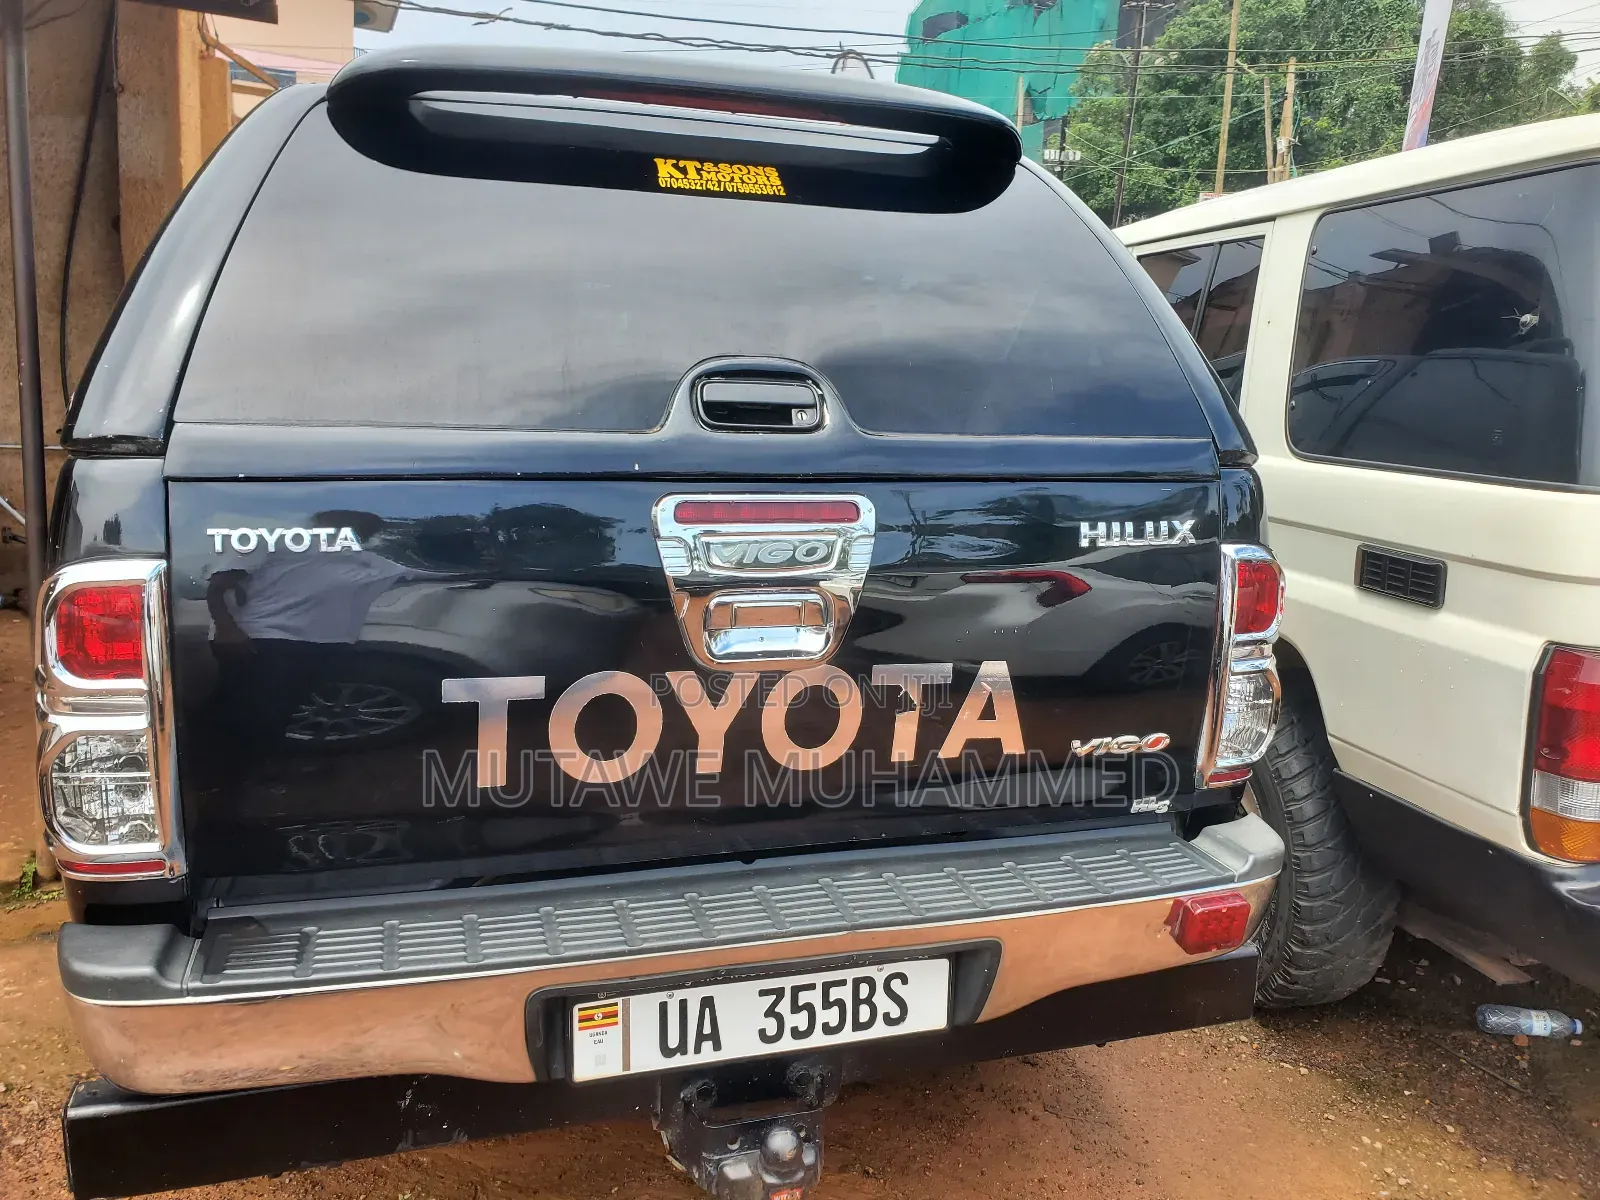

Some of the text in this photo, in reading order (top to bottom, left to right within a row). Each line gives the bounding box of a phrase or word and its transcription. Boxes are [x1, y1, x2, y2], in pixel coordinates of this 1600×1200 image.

[654, 158, 779, 179] KT &SONS
[700, 171, 782, 186] MOTORS
[206, 527, 363, 553] TOYOTA
[1079, 520, 1196, 547] HILUX
[709, 541, 828, 564] VIGO
[442, 660, 1025, 787] TOYOTA
[1070, 732, 1171, 757] VIGO
[658, 995, 722, 1059] UA
[758, 971, 909, 1045] 355BS
